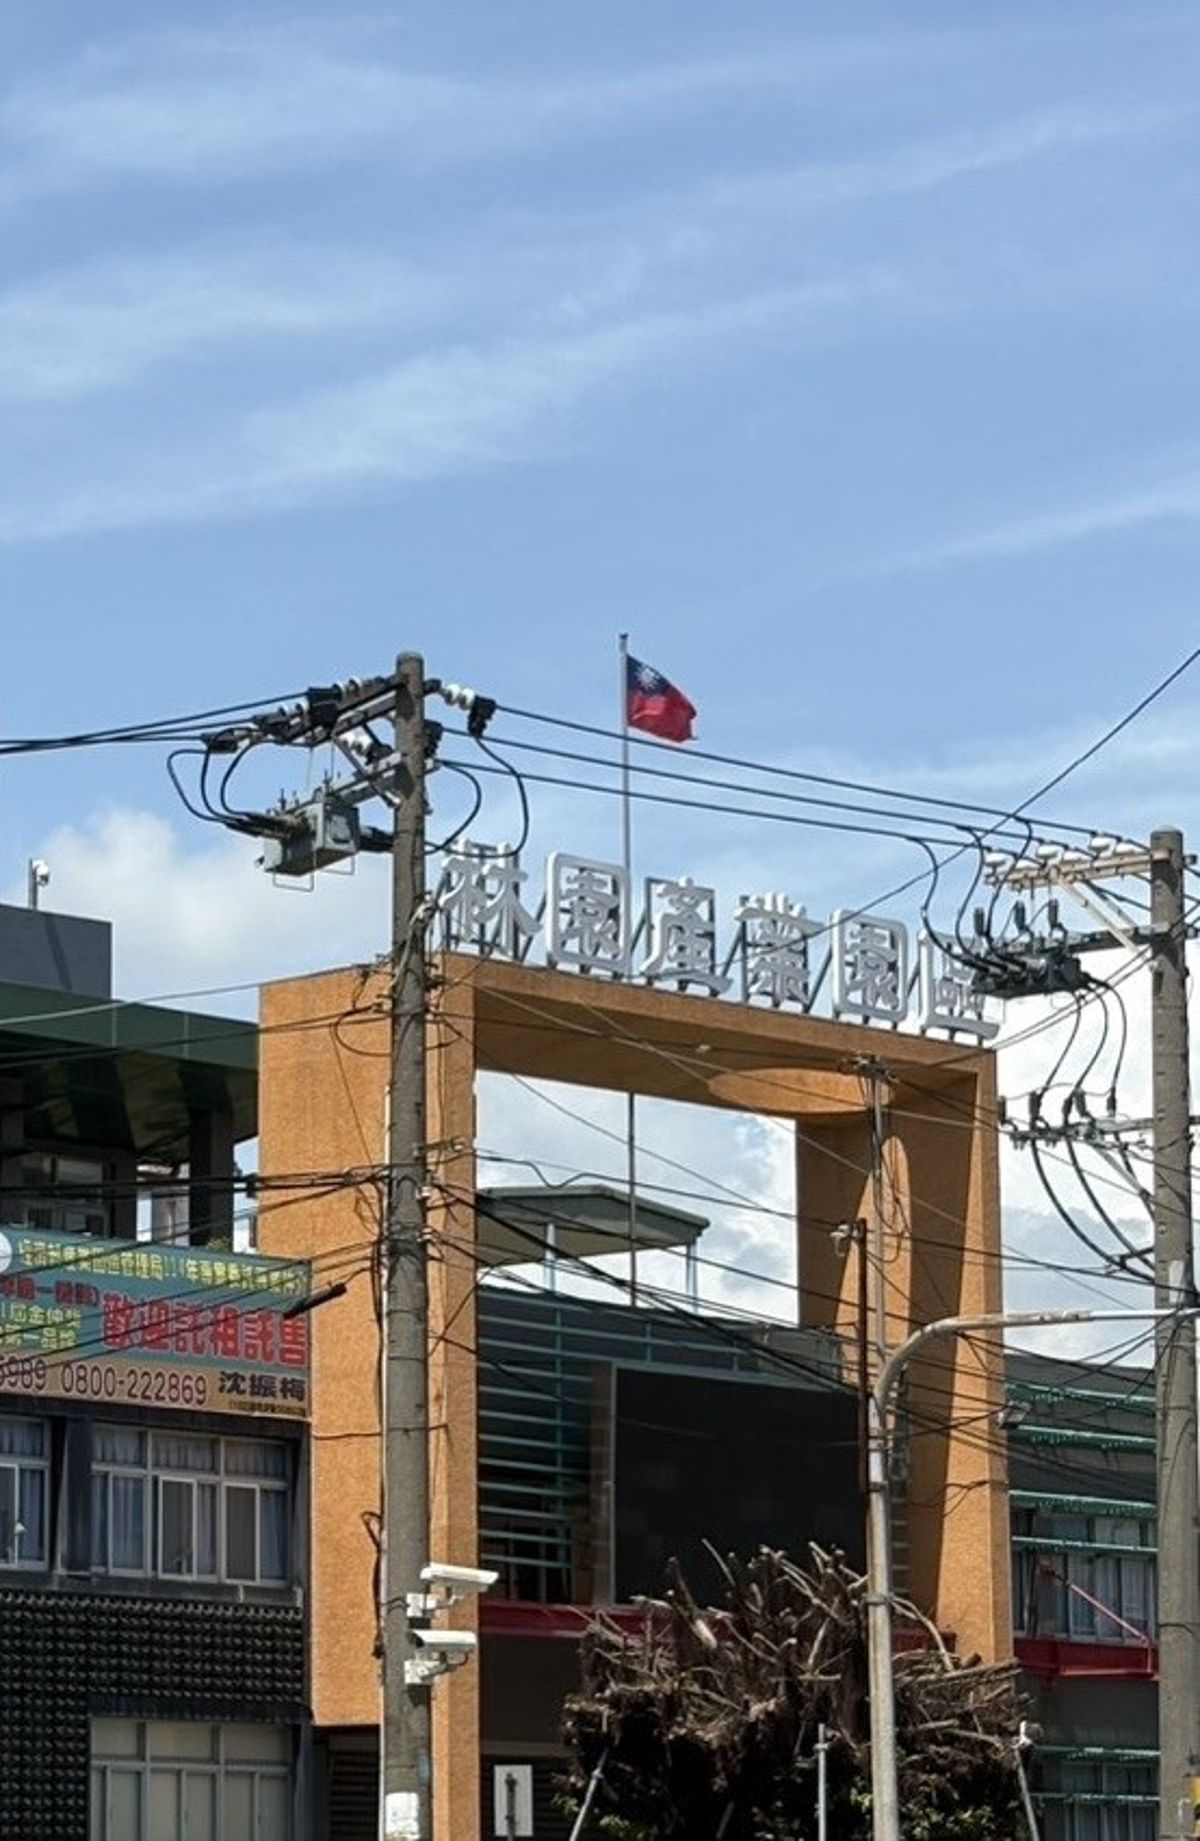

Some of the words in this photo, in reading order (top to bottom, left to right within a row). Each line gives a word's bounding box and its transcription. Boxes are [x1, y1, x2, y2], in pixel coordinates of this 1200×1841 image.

[440, 838, 1002, 1040] 林園產業園區
[61, 1364, 207, 1406] 0800-222869
